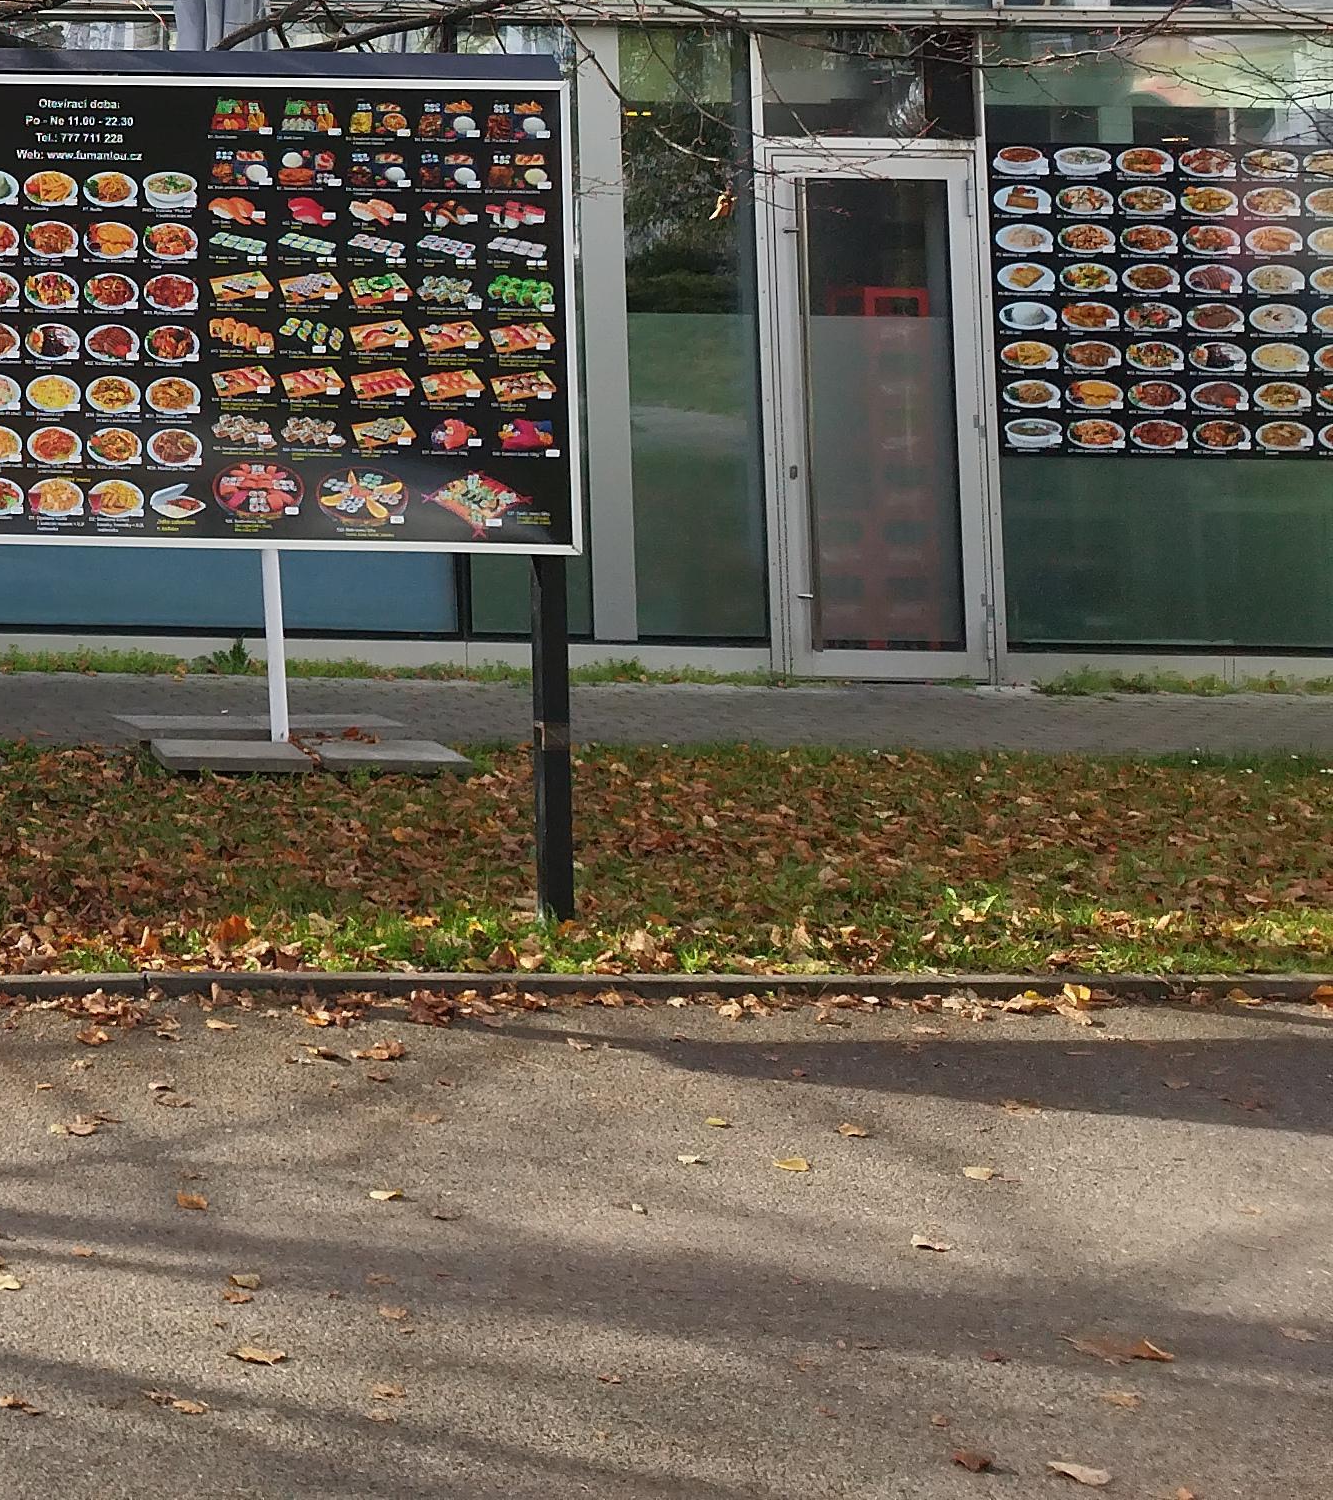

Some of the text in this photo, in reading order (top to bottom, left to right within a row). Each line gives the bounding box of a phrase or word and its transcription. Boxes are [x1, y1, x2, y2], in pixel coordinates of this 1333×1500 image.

[25, 115, 41, 126] Po
[50, 116, 65, 126] Ne
[68, 116, 96, 126] 11.00
[105, 116, 134, 127] 22.30
[61, 133, 80, 143] 777
[83, 133, 100, 143] 711
[104, 134, 124, 144] 228
[16, 149, 143, 161] Web: www.fumanlou.cz
